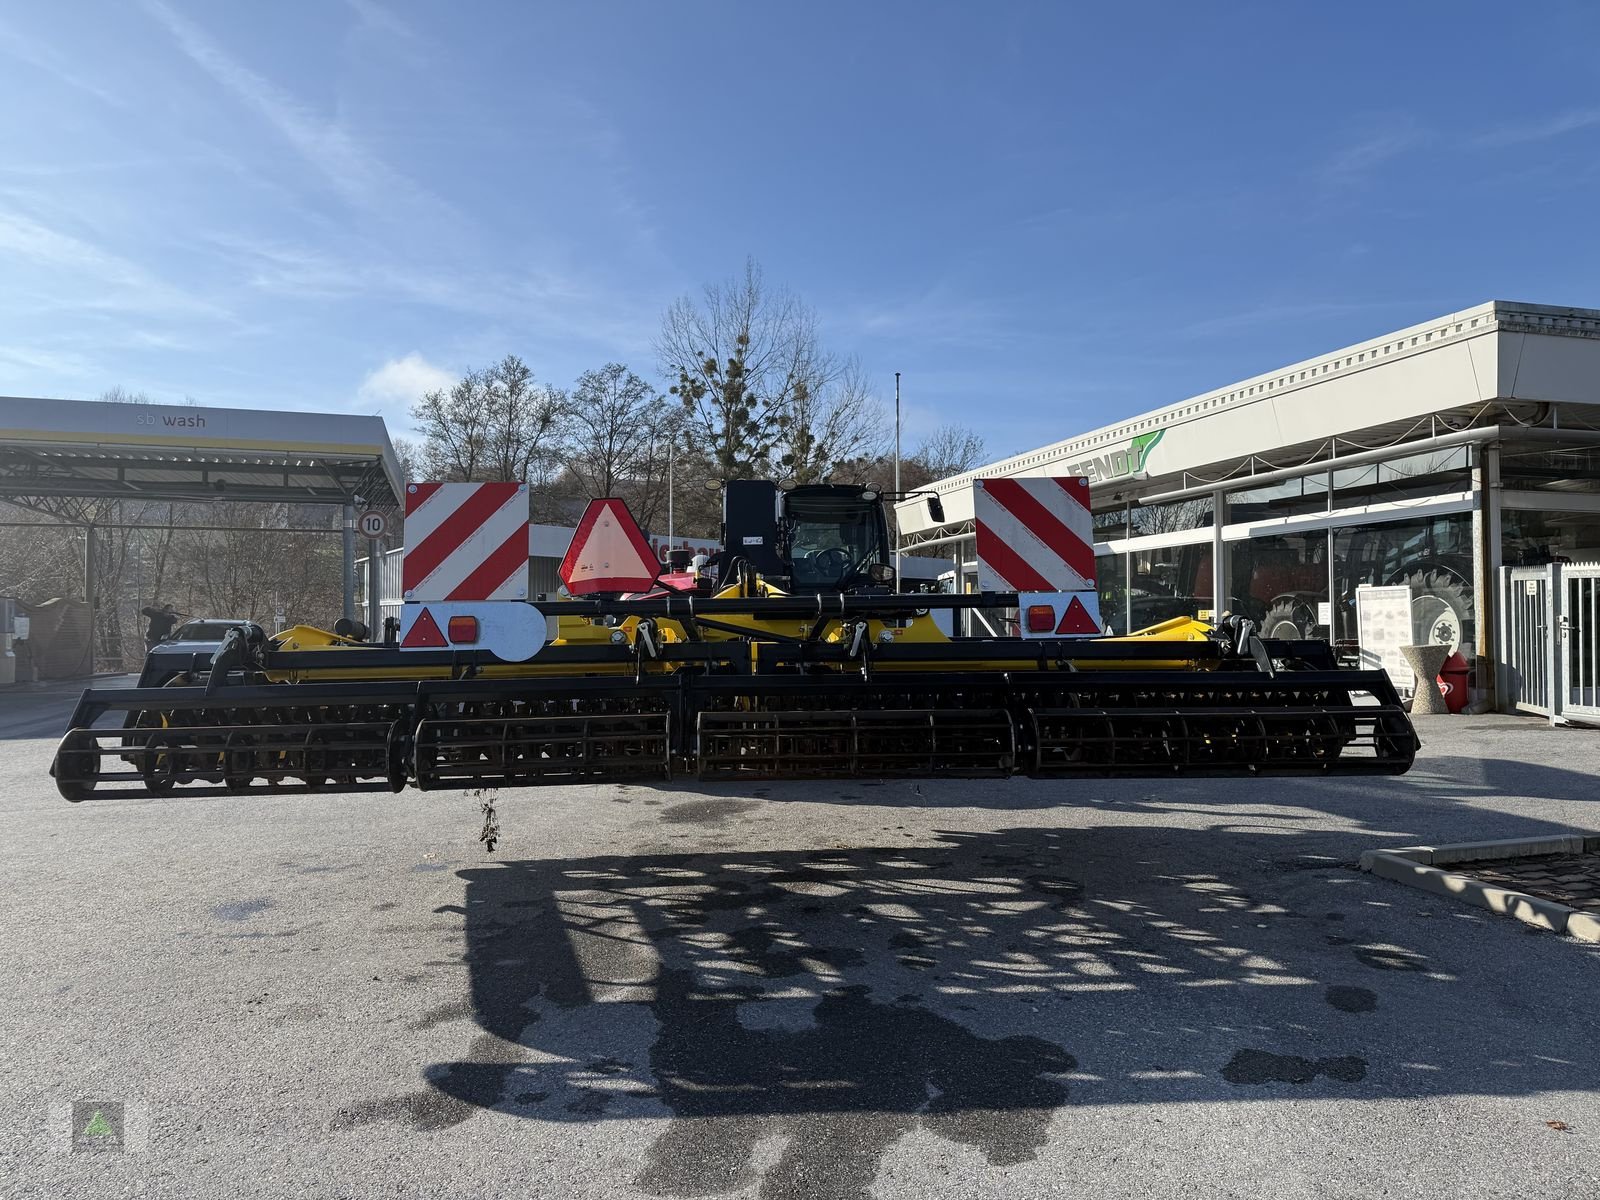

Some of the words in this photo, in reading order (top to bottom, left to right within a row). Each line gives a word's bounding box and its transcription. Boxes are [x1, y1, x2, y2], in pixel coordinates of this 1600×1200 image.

[136, 412, 155, 425] sb
[162, 414, 206, 428] wash
[1066, 445, 1143, 483] FENDT
[365, 518, 381, 531] 10
